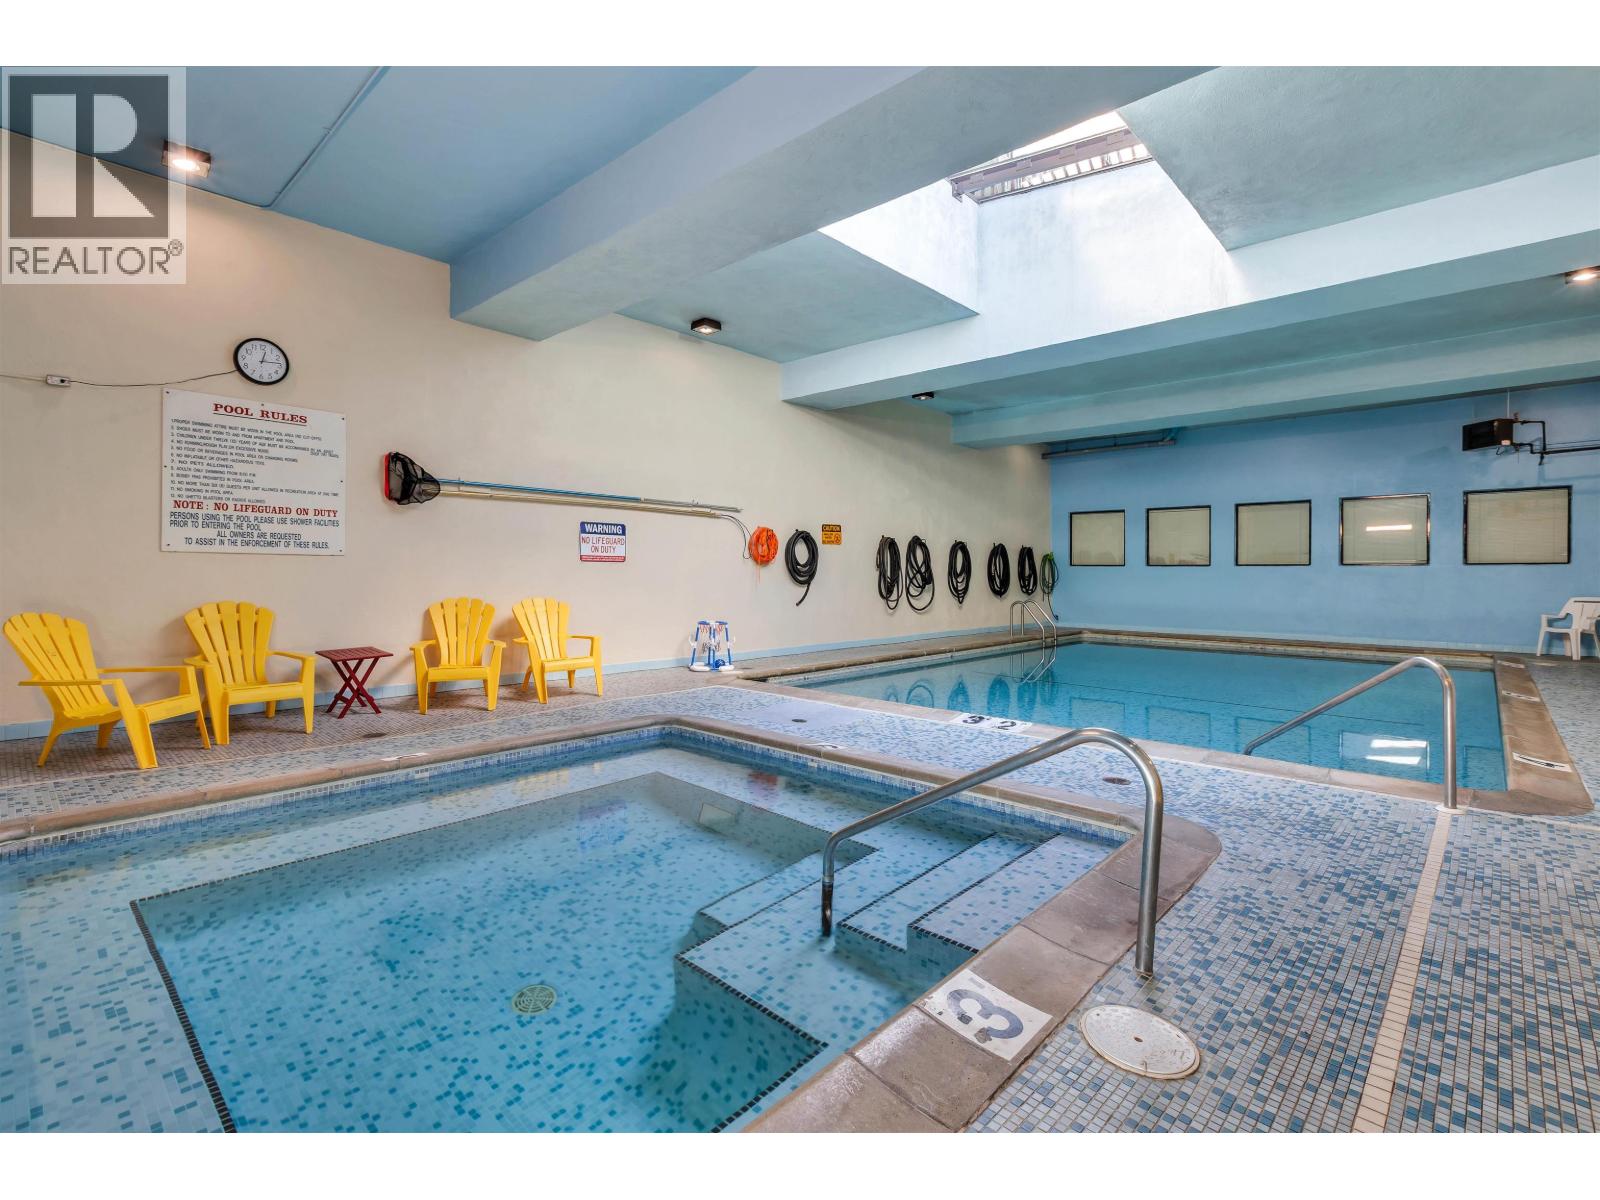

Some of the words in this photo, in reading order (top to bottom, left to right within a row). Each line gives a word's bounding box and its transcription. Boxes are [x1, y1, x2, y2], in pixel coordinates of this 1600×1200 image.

[213, 403, 253, 416] POOL
[260, 410, 307, 424] RULES
[214, 502, 229, 511] NO
[233, 504, 292, 515] LIFEGUARD
[296, 508, 309, 516] ON
[314, 509, 338, 518] DUTY
[170, 512, 199, 520] PERSONS
[584, 524, 622, 534] WARNING
[592, 537, 624, 546] LIFEGUARD
